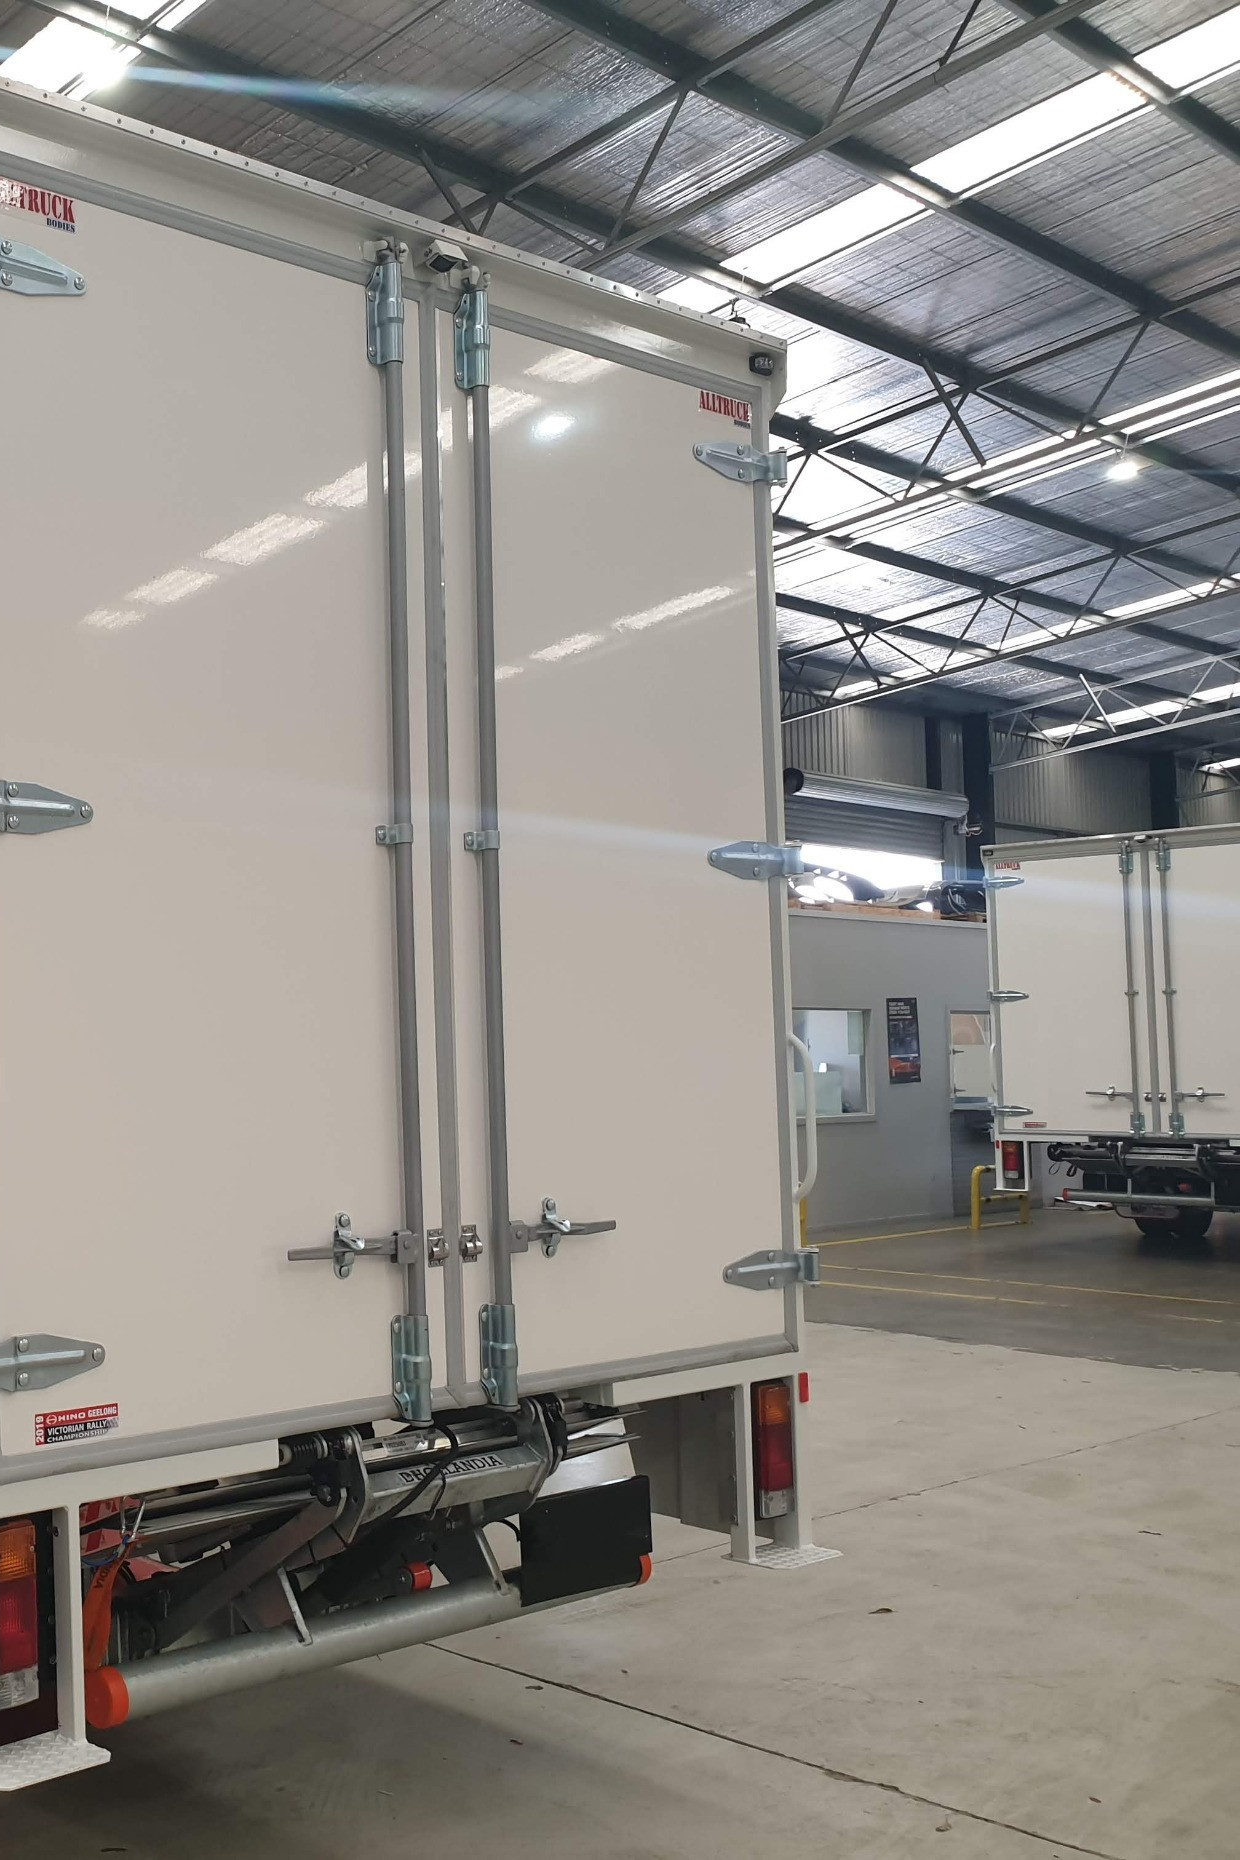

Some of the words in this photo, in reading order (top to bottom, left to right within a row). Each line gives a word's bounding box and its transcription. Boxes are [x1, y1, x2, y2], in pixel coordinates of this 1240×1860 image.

[46, 218, 75, 233] BODIES
[58, 1412, 86, 1422] HINO
[88, 1406, 117, 1418] GEELONG
[36, 1415, 44, 1443] 2019
[47, 1423, 85, 1436] VICTORIAN
[86, 1420, 107, 1430] RALLY
